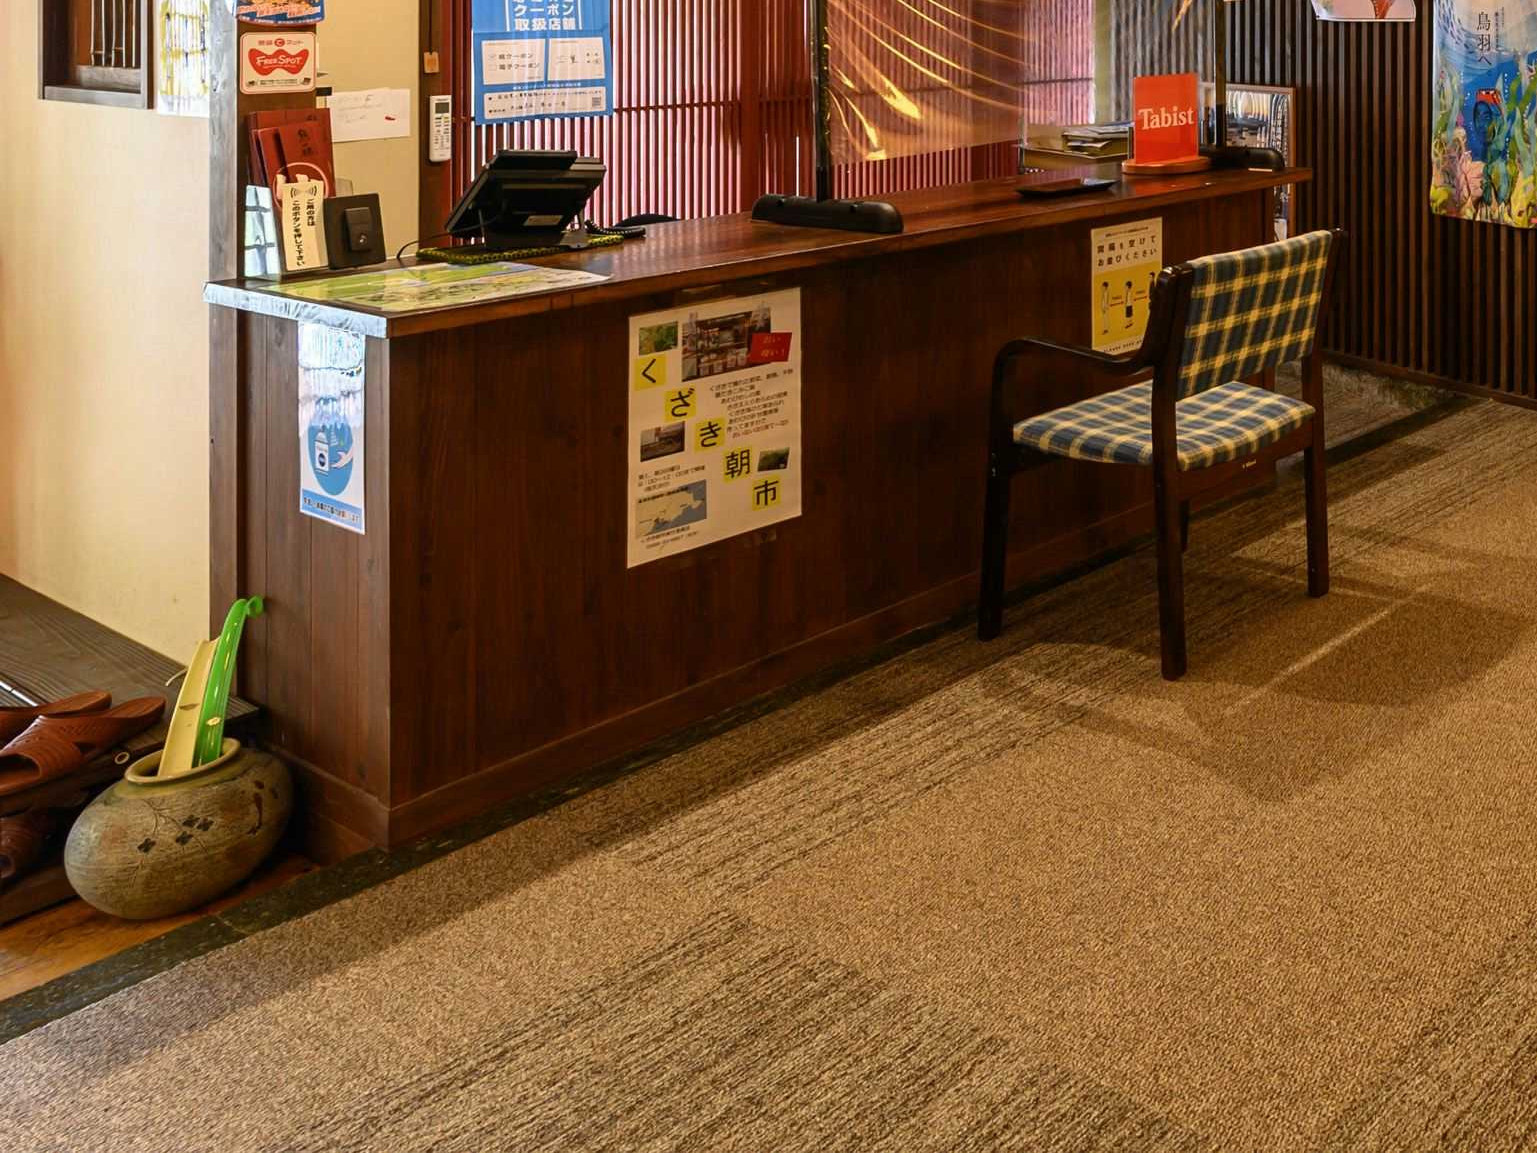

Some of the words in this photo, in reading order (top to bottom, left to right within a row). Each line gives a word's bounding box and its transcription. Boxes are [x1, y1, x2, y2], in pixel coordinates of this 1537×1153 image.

[513, 4, 575, 17] クーポン
[1138, 106, 1195, 130] Tabist
